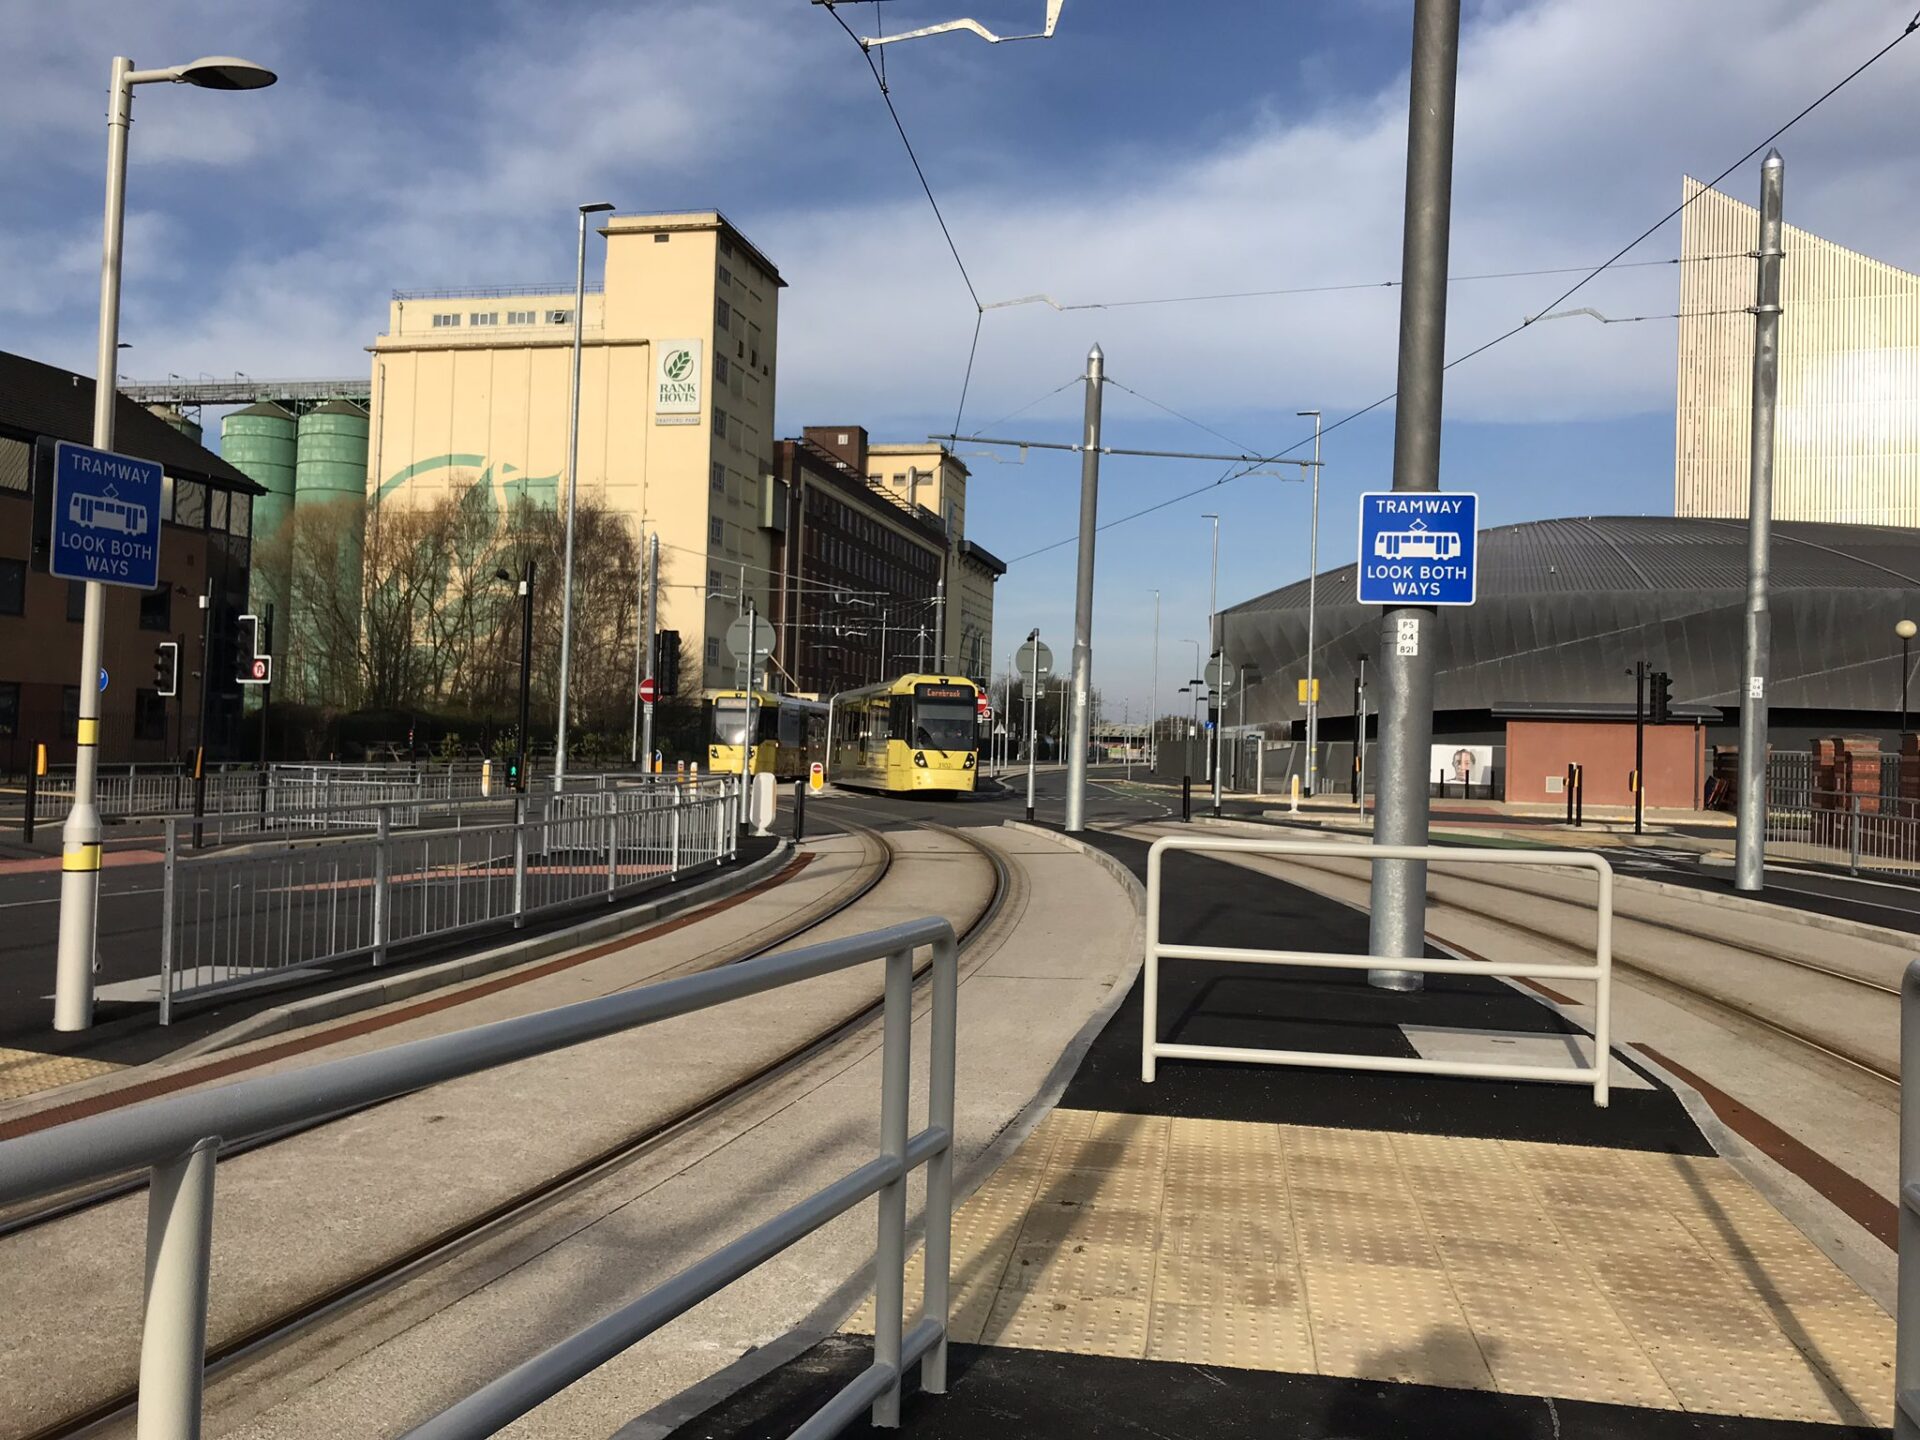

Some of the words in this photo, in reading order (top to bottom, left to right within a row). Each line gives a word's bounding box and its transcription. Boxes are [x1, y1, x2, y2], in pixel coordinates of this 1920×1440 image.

[660, 383, 696, 393] RANK
[659, 393, 697, 403] HOVIS
[72, 453, 150, 485] TRAMWAY
[1376, 500, 1462, 514] TRAMWAY
[62, 531, 105, 554] LOOK
[111, 540, 152, 561] BOTH
[85, 555, 129, 576] WAYS
[1367, 565, 1413, 579] LOOK
[1420, 566, 1466, 580] BOTH
[1392, 582, 1441, 596] WAYS
[1402, 621, 1414, 629] PS
[1401, 633, 1414, 641] 04
[927, 687, 961, 697] Cornbrook
